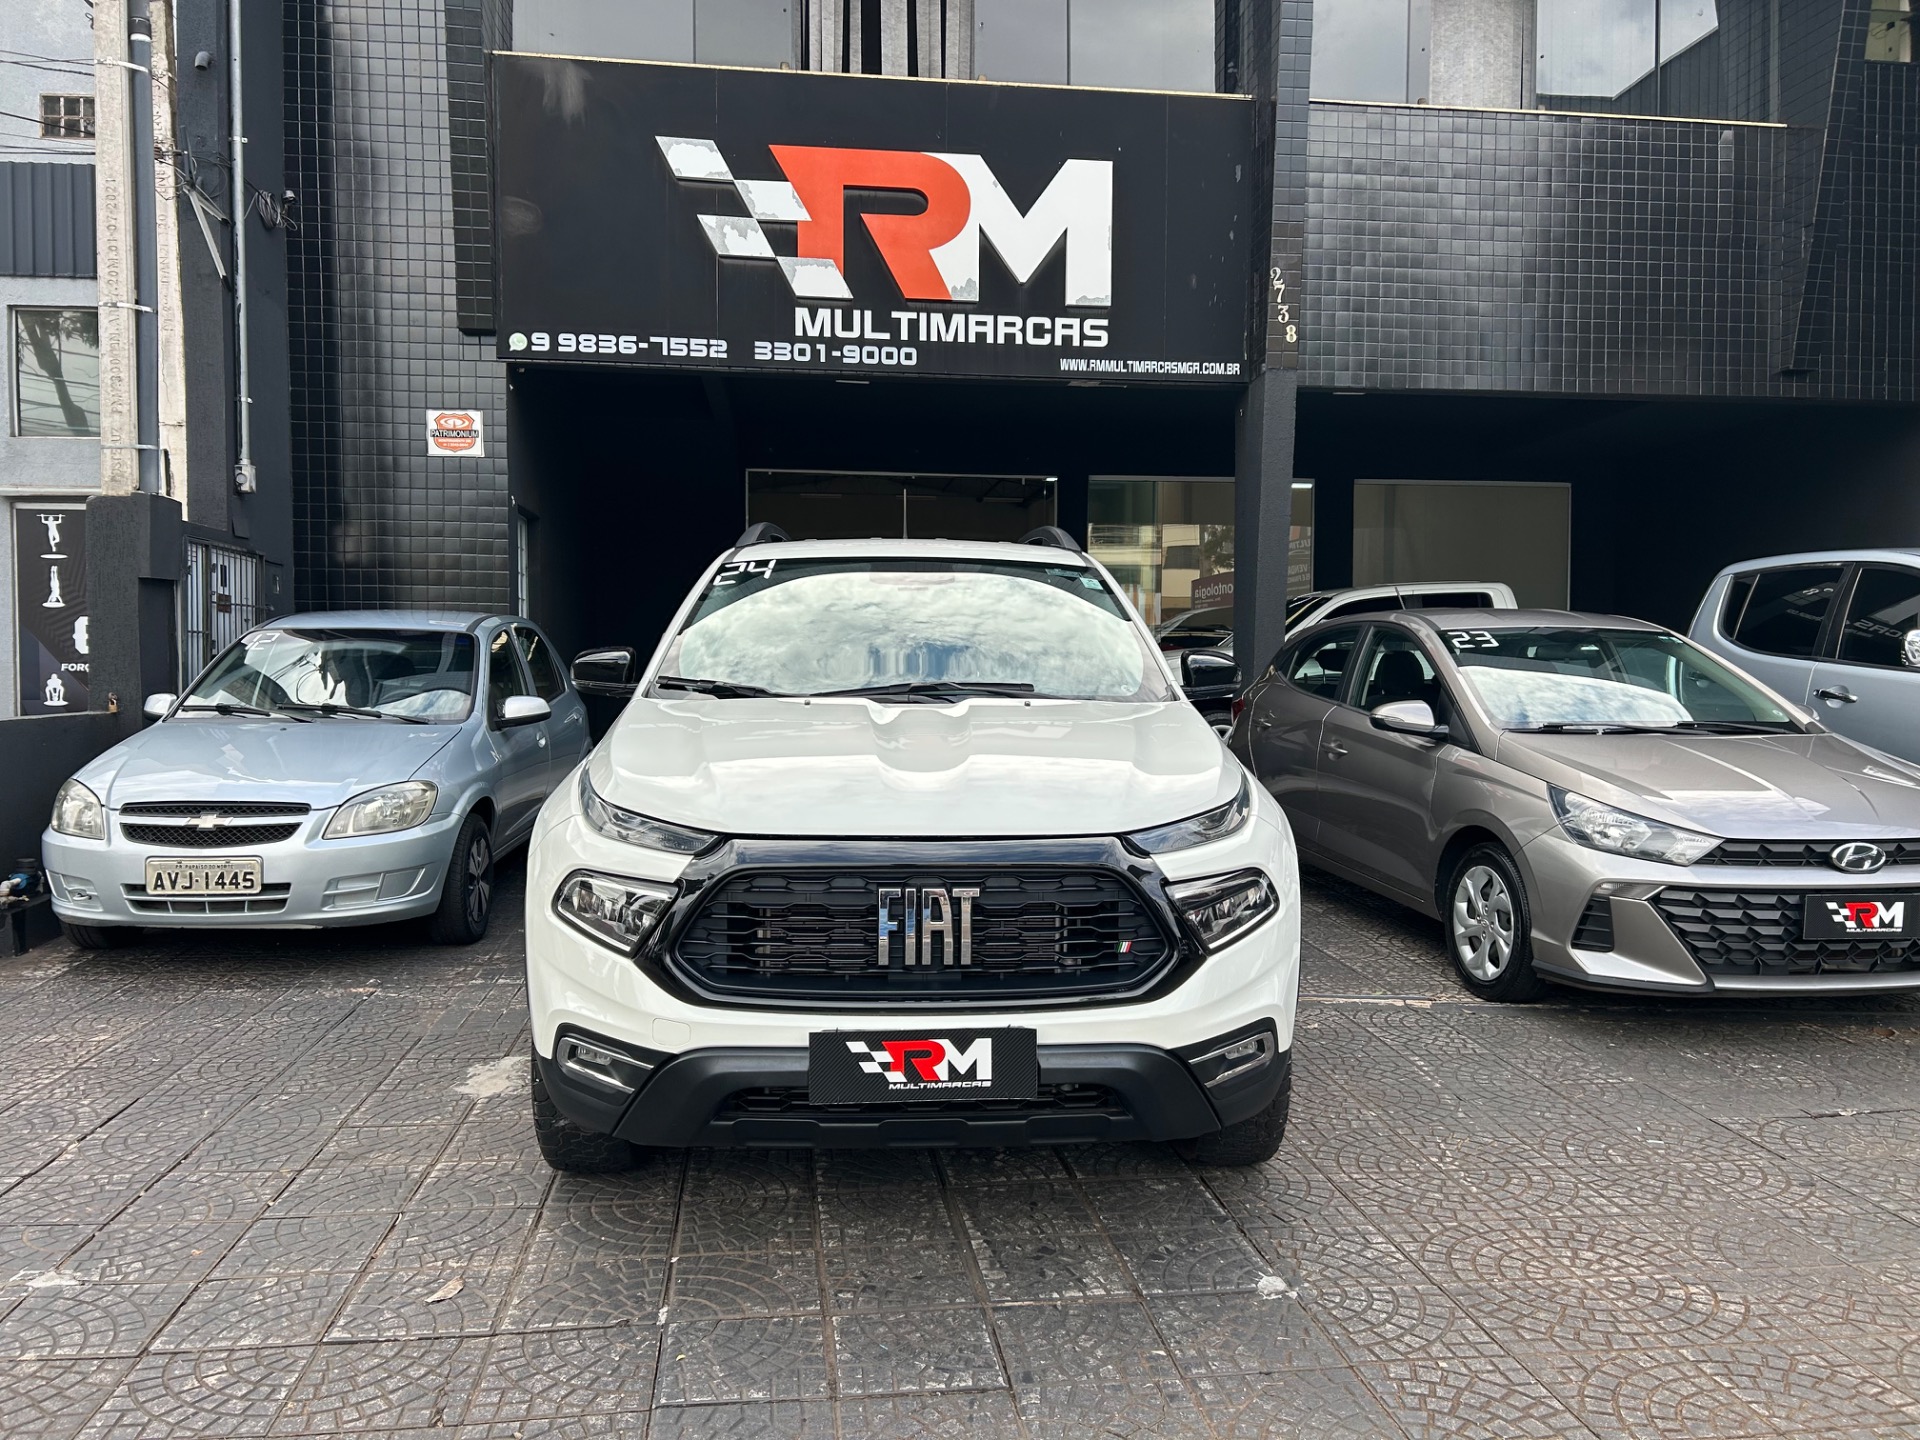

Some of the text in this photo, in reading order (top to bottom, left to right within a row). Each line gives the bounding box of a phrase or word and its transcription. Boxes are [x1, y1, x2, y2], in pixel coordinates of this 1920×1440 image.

[769, 144, 1113, 307] RM
[794, 307, 1109, 347] MULTIMARCAS
[531, 332, 728, 359] 9 9836-7552
[754, 340, 918, 366] 3301-9000
[1060, 358, 1241, 375] WWW.RMMULTIMARCASMGA.COM.BR
[431, 429, 479, 438] PATRIMONIUM
[713, 559, 776, 586] 24
[245, 632, 281, 650] 12
[1447, 631, 1500, 649] 23
[878, 888, 980, 966] FIAT
[1845, 902, 1905, 928] RM
[882, 1038, 992, 1081] RM
[888, 1080, 992, 1090] MULTIMARCAS
